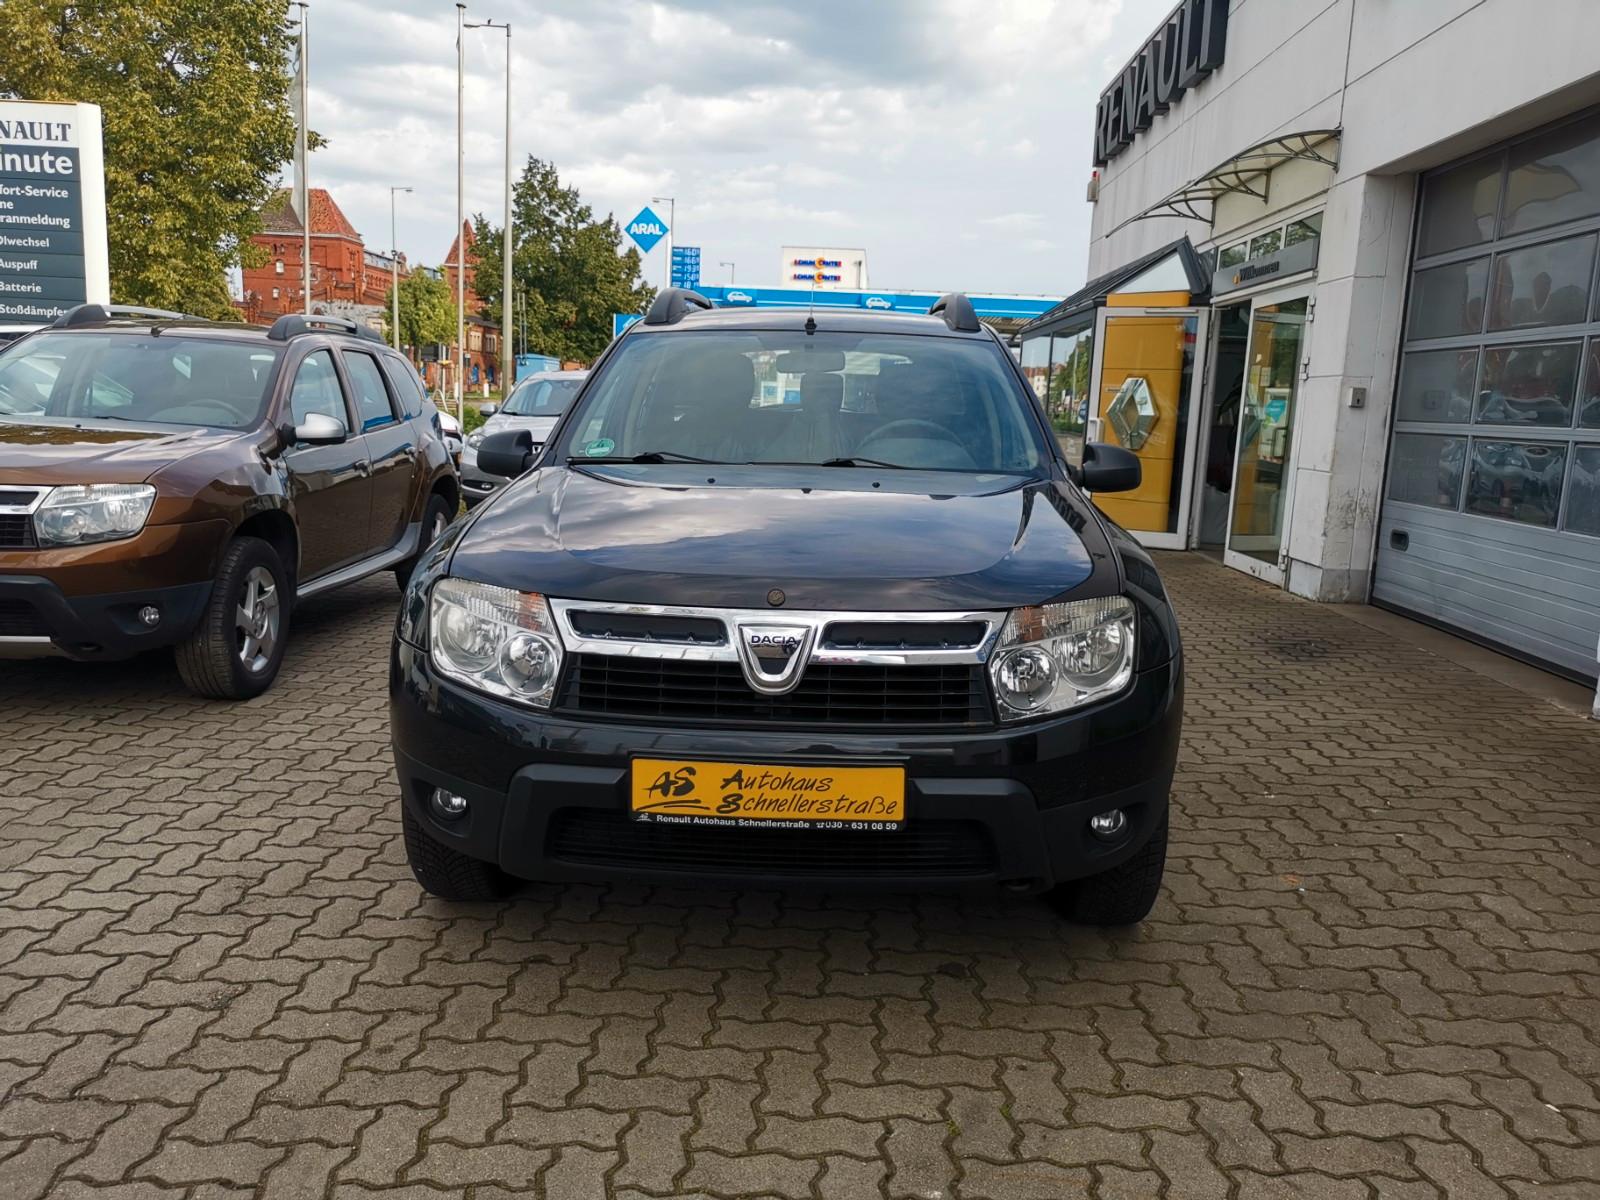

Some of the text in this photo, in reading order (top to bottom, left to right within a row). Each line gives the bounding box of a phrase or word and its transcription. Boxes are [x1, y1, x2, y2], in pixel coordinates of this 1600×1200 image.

[1092, 0, 1229, 167] RENAULT
[0, 120, 71, 141] NAULT
[0, 213, 71, 229] ranmeldung
[630, 223, 663, 235] ARAL
[0, 258, 38, 271] Auspuff
[0, 281, 42, 293] Batterie
[751, 635, 797, 644] DACIA
[641, 766, 697, 799] AS
[720, 768, 834, 792] Autohaus
[716, 793, 898, 815] Schnellerstraße
[656, 814, 692, 824] Renault
[693, 816, 736, 826] Autohaus
[739, 818, 810, 829] Schnellerstraße
[851, 822, 868, 830] 631
[885, 822, 898, 830] 59
